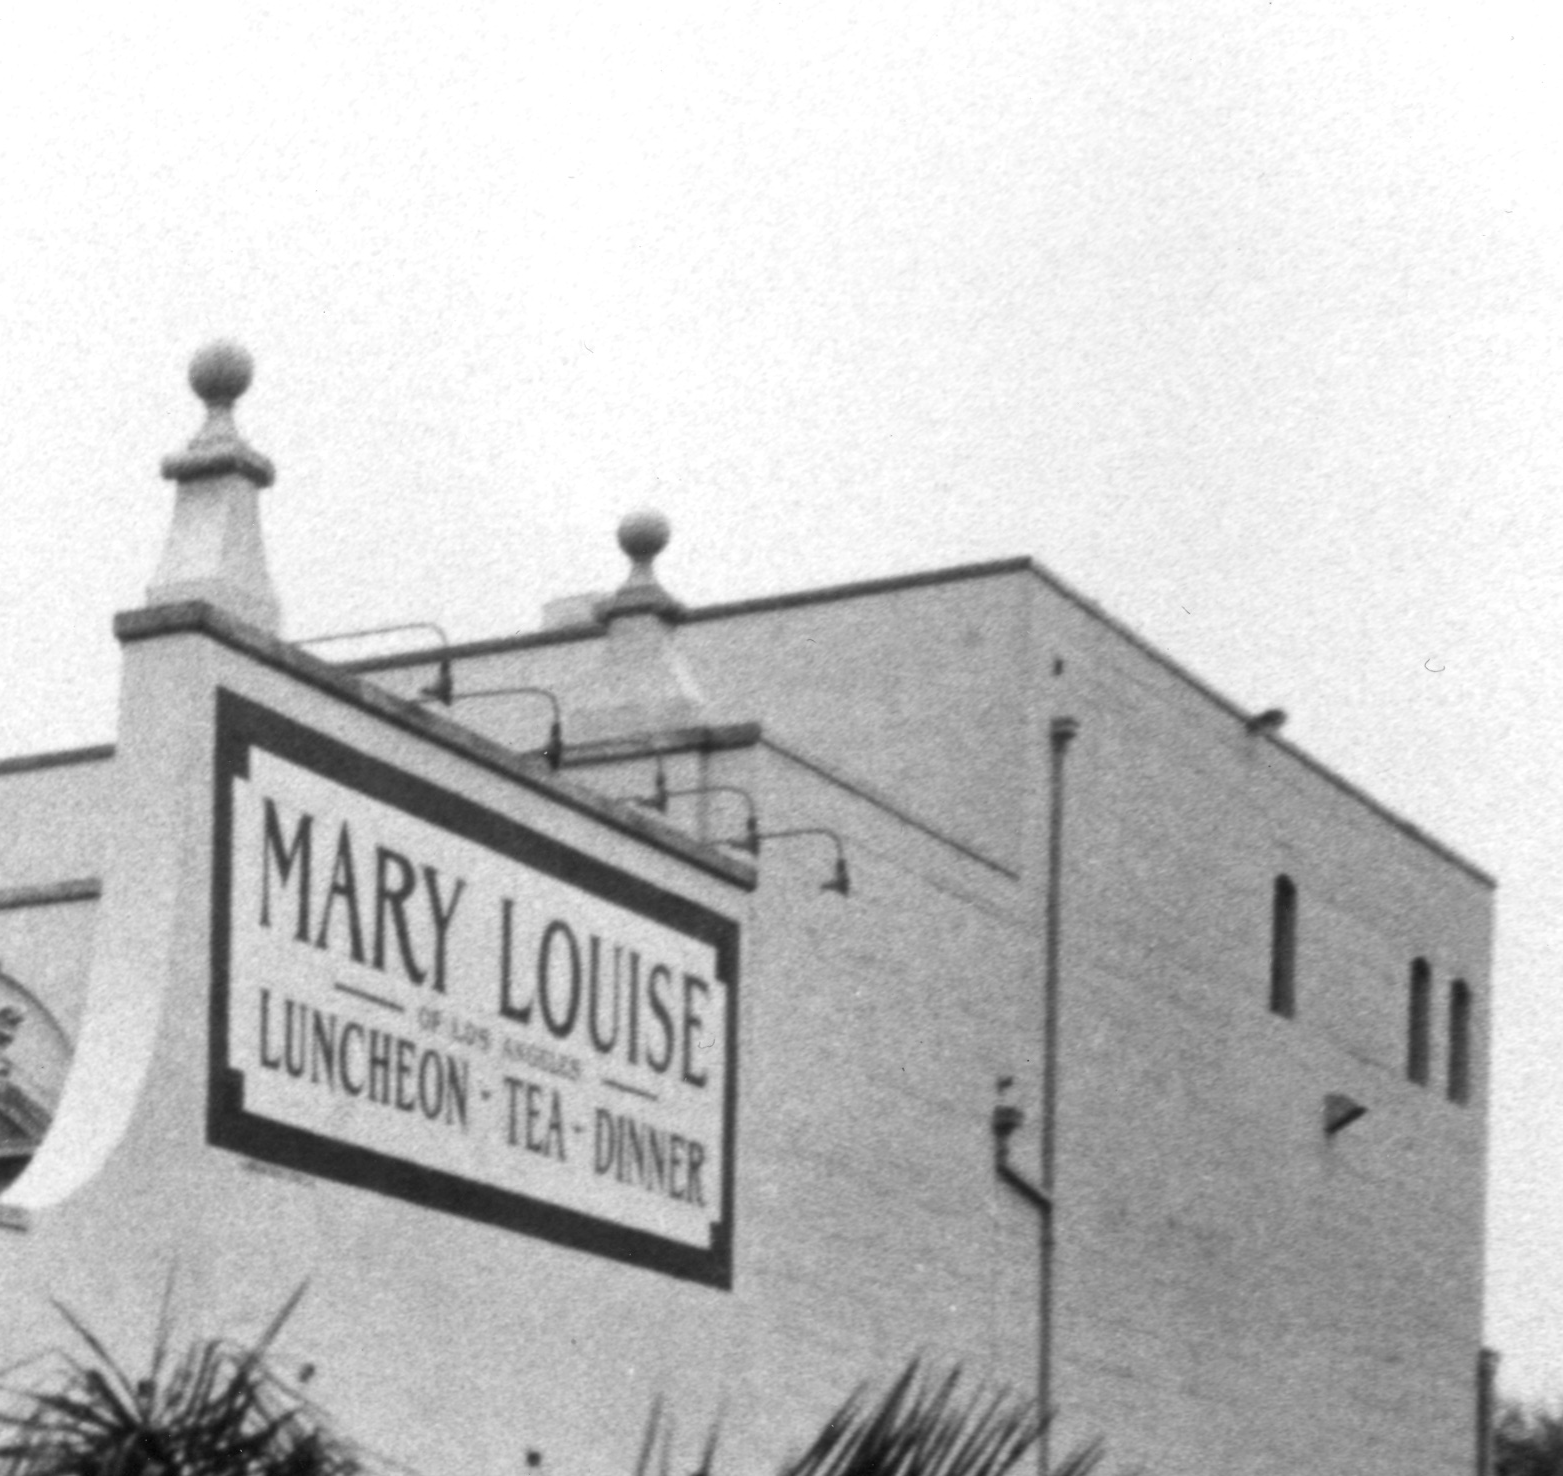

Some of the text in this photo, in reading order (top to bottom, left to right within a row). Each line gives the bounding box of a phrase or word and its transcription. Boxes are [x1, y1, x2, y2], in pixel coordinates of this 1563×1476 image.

[259, 797, 710, 1089] MARY LOUISE
[259, 988, 706, 1208] LUNCHEON TEA DINNER
